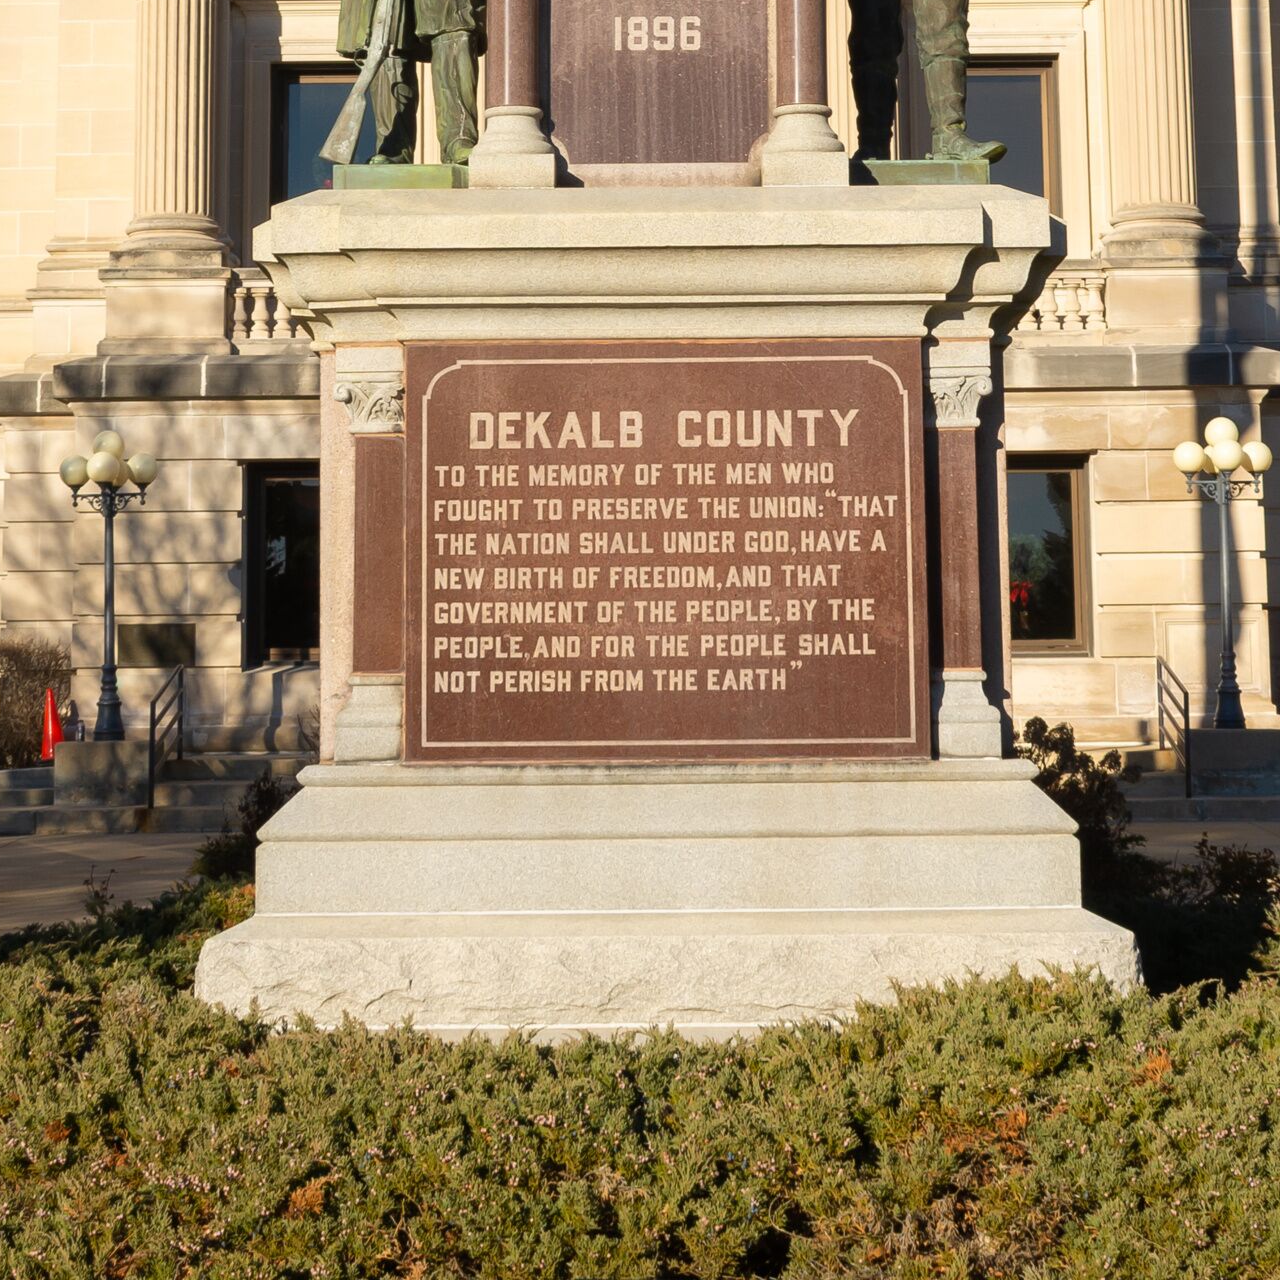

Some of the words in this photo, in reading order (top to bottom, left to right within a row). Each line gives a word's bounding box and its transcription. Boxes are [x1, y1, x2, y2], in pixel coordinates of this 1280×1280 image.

[614, 16, 701, 51] 1896
[470, 411, 643, 449] DEKALB
[678, 409, 859, 447] COUNTY
[435, 465, 464, 487] TO
[475, 465, 519, 487] THE
[529, 464, 624, 486] MEMORY
[635, 464, 662, 485] OF
[673, 463, 716, 485] THE
[726, 463, 771, 484] MEN
[782, 462, 834, 484] WHO
[435, 499, 523, 521] FOUGHT
[533, 499, 562, 520] TO
[573, 498, 688, 520] PRESERVE
[698, 497, 740, 518] THE
[750, 496, 824, 518] UNION:
[435, 534, 476, 555] THE
[486, 533, 569, 555] NATION
[580, 532, 653, 554] SHALL
[664, 531, 734, 553] UNDER
[745, 531, 796, 555] GOD,
[801, 530, 861, 552] HAVE
[871, 530, 887, 551] A
[435, 568, 484, 589] NEW
[494, 567, 563, 589] BIRTH
[573, 567, 600, 588] OF
[610, 566, 722, 591] FREEDOM,
[726, 566, 771, 587] AND
[781, 565, 841, 587] THAT
[435, 601, 587, 624] GOVERNMENT
[597, 601, 625, 623] OF
[634, 601, 676, 623] THE
[686, 600, 780, 624] PEOPLE,
[787, 599, 817, 621] BY
[828, 599, 874, 621] THE
[435, 637, 530, 662] PEOPLE,
[533, 636, 580, 658] AND
[591, 636, 634, 657] FOR
[645, 635, 689, 657] THE
[701, 634, 786, 656] PEOPLE
[799, 633, 875, 655] SHALL
[435, 671, 480, 692] NOT
[490, 670, 571, 692] PERISH
[581, 670, 643, 692] FROM
[653, 669, 697, 691] THE
